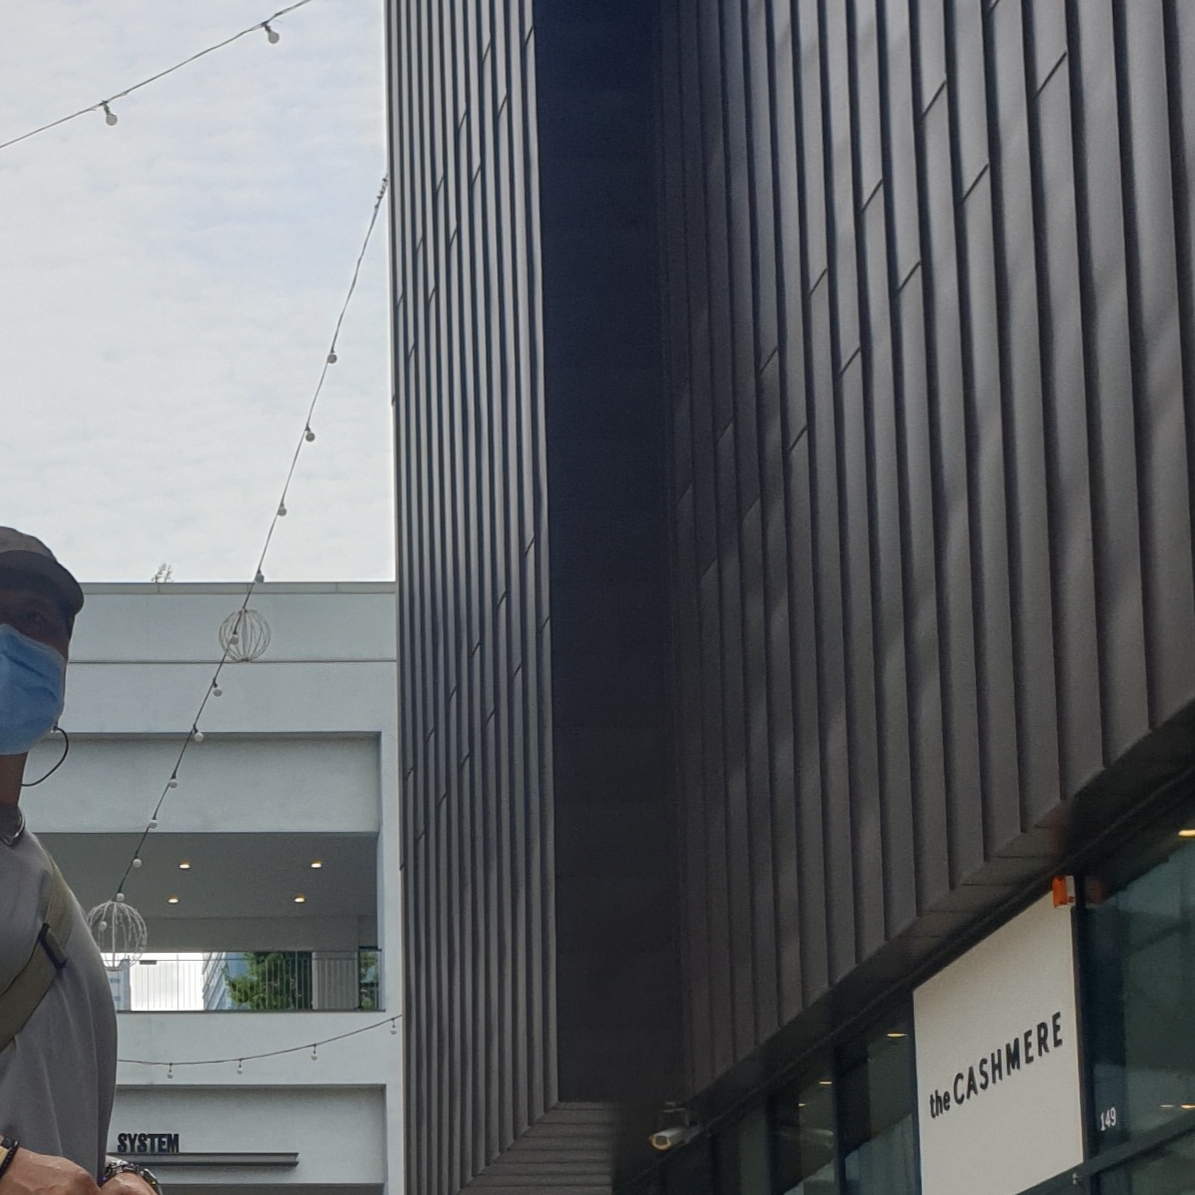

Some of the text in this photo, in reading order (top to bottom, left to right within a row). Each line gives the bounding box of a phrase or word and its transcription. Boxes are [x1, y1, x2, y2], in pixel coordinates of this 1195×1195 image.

[929, 1011, 1063, 1119] the CASHMERE
[1100, 1106, 1117, 1132] 149
[117, 1132, 180, 1153] SYSTEM
